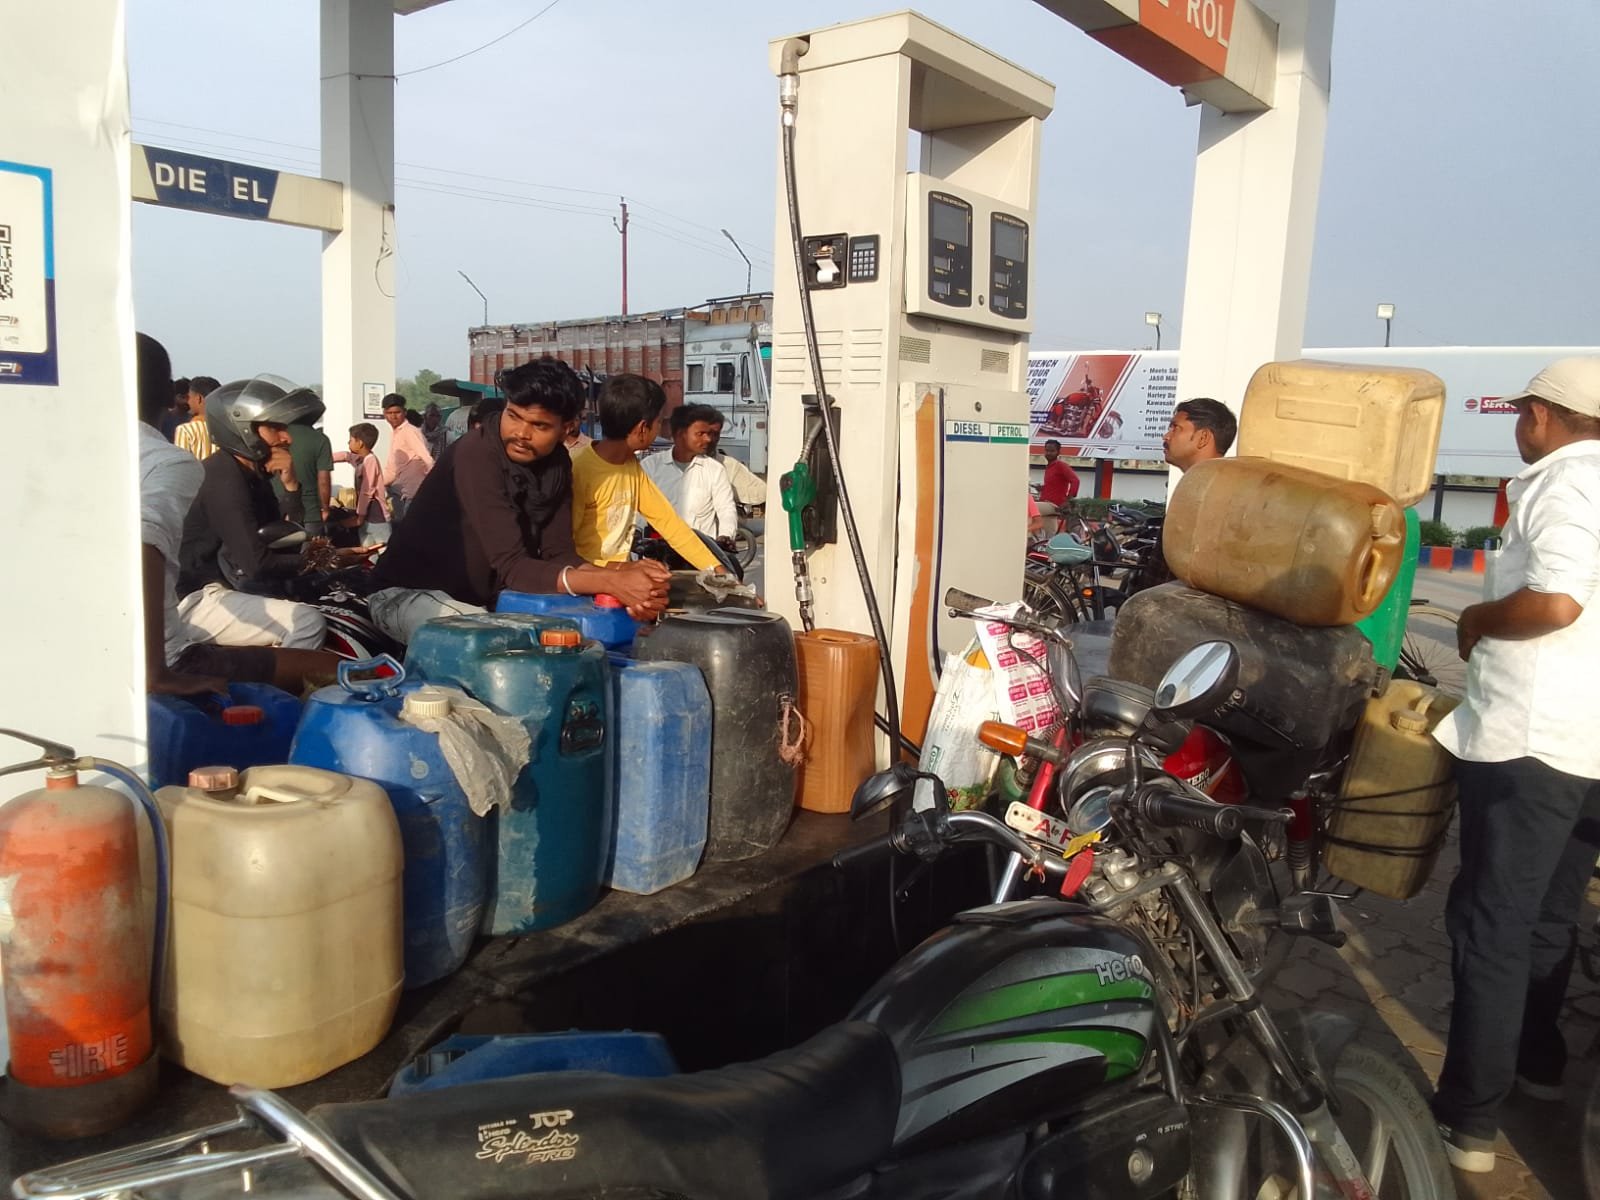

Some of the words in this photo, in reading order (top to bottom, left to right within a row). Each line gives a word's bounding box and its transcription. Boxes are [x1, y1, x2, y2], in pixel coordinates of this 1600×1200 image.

[953, 422, 983, 435] DIESEL
[997, 425, 1023, 437] PETROL
[1095, 954, 1144, 987] Hero
